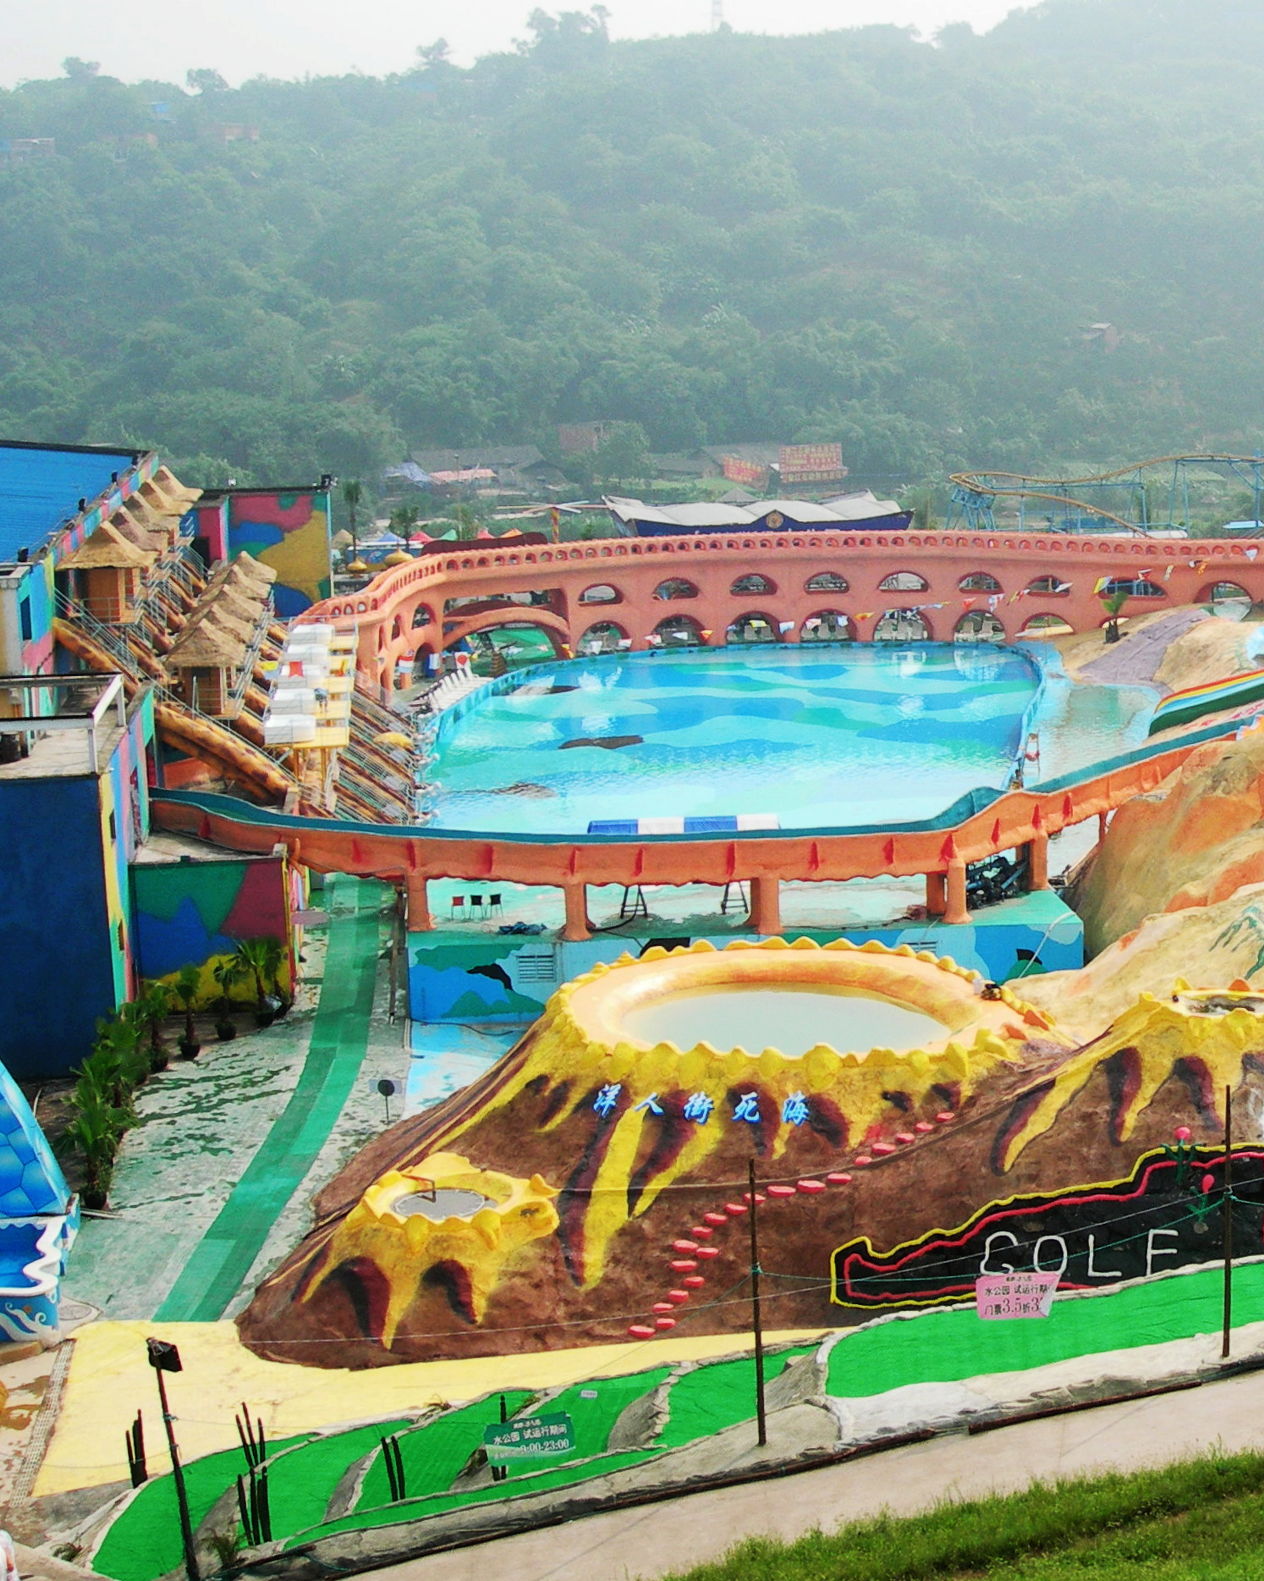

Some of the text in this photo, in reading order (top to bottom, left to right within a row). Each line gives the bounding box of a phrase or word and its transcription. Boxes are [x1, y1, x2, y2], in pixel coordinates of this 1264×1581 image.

[592, 1083, 810, 1125] 洋人街死海
[979, 1228, 1179, 1277] GOLF
[985, 1285, 1010, 1297] 水公园
[984, 1297, 1043, 1316] 门票3.5折3
[493, 1431, 520, 1446] 水公园
[523, 1423, 567, 1439] 试运行期间
